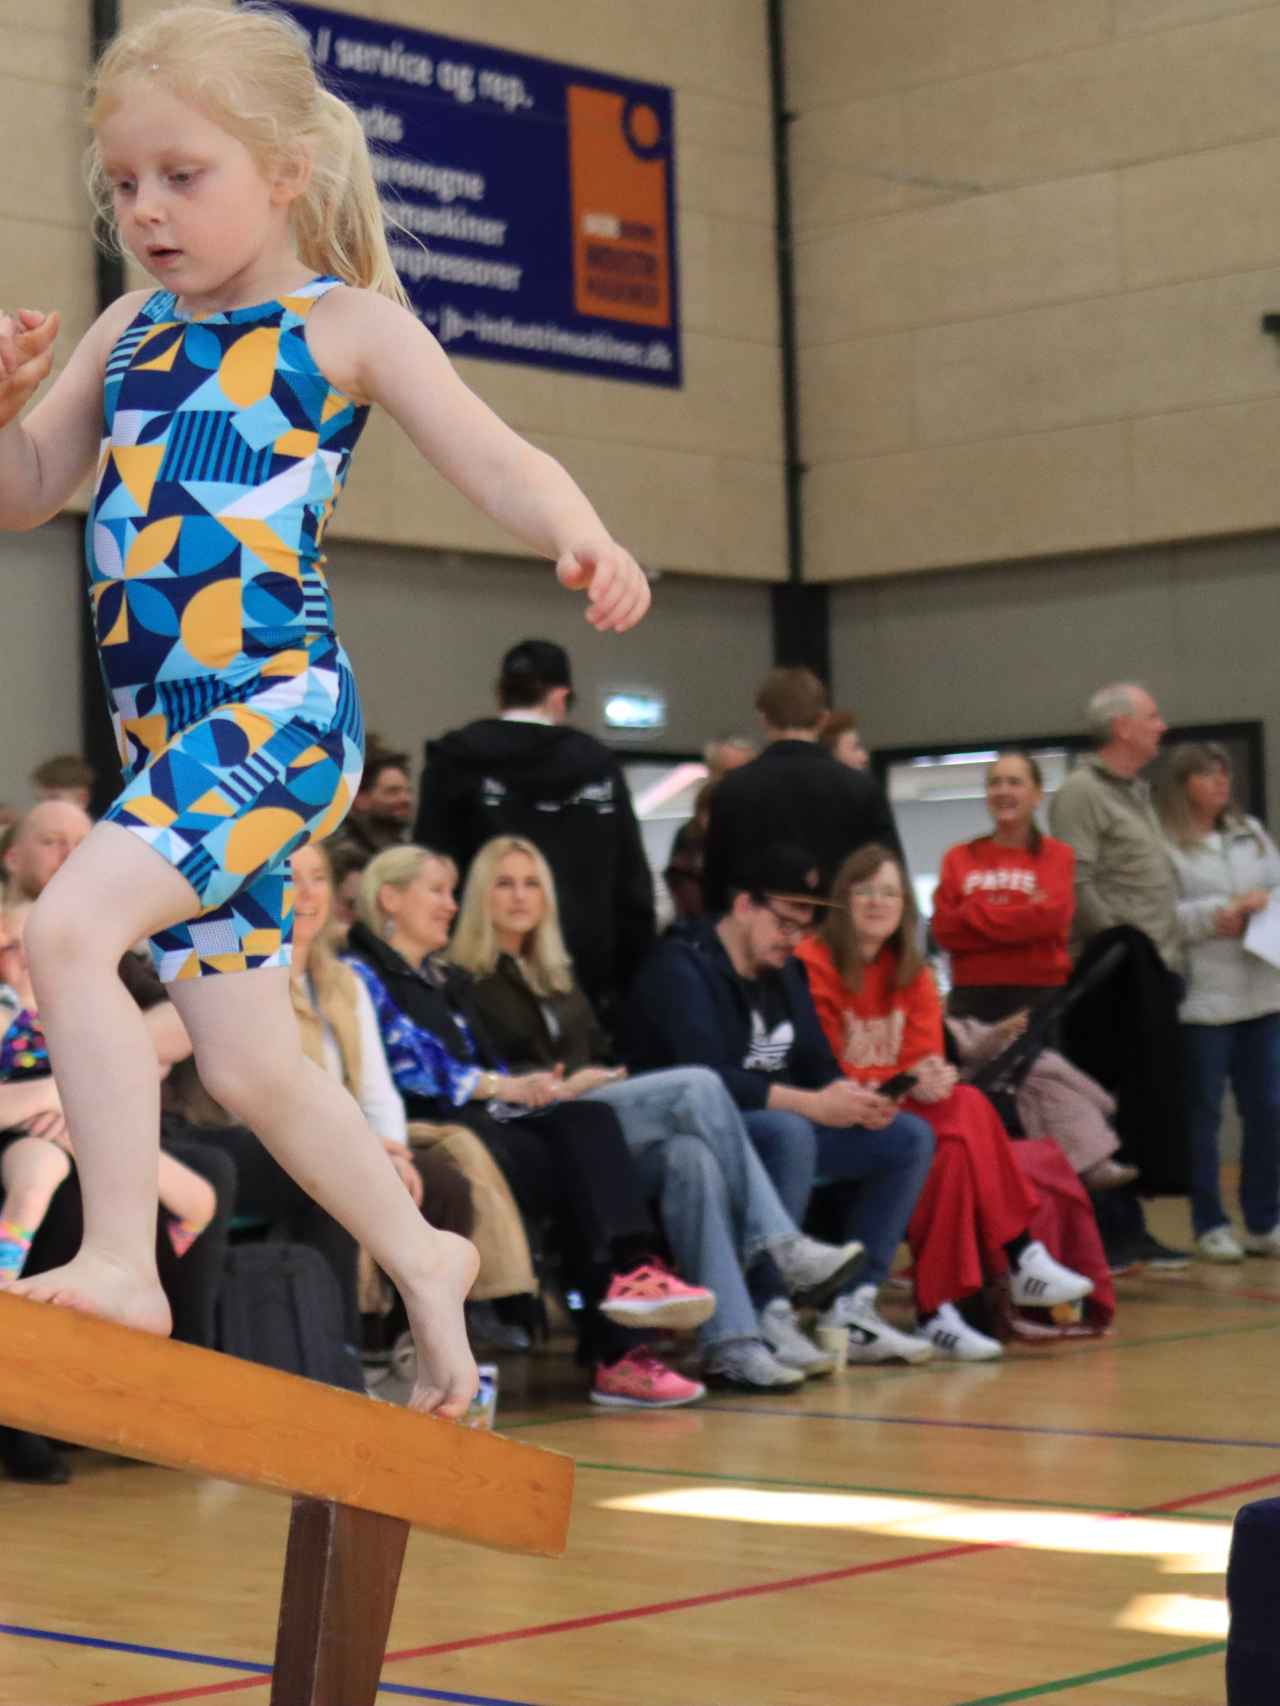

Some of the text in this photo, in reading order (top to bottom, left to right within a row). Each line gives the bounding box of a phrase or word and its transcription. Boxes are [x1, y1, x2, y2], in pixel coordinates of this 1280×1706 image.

[335, 37, 433, 87] service
[437, 60, 475, 104] og
[478, 69, 534, 113] rep.
[391, 246, 522, 292] mpressorer
